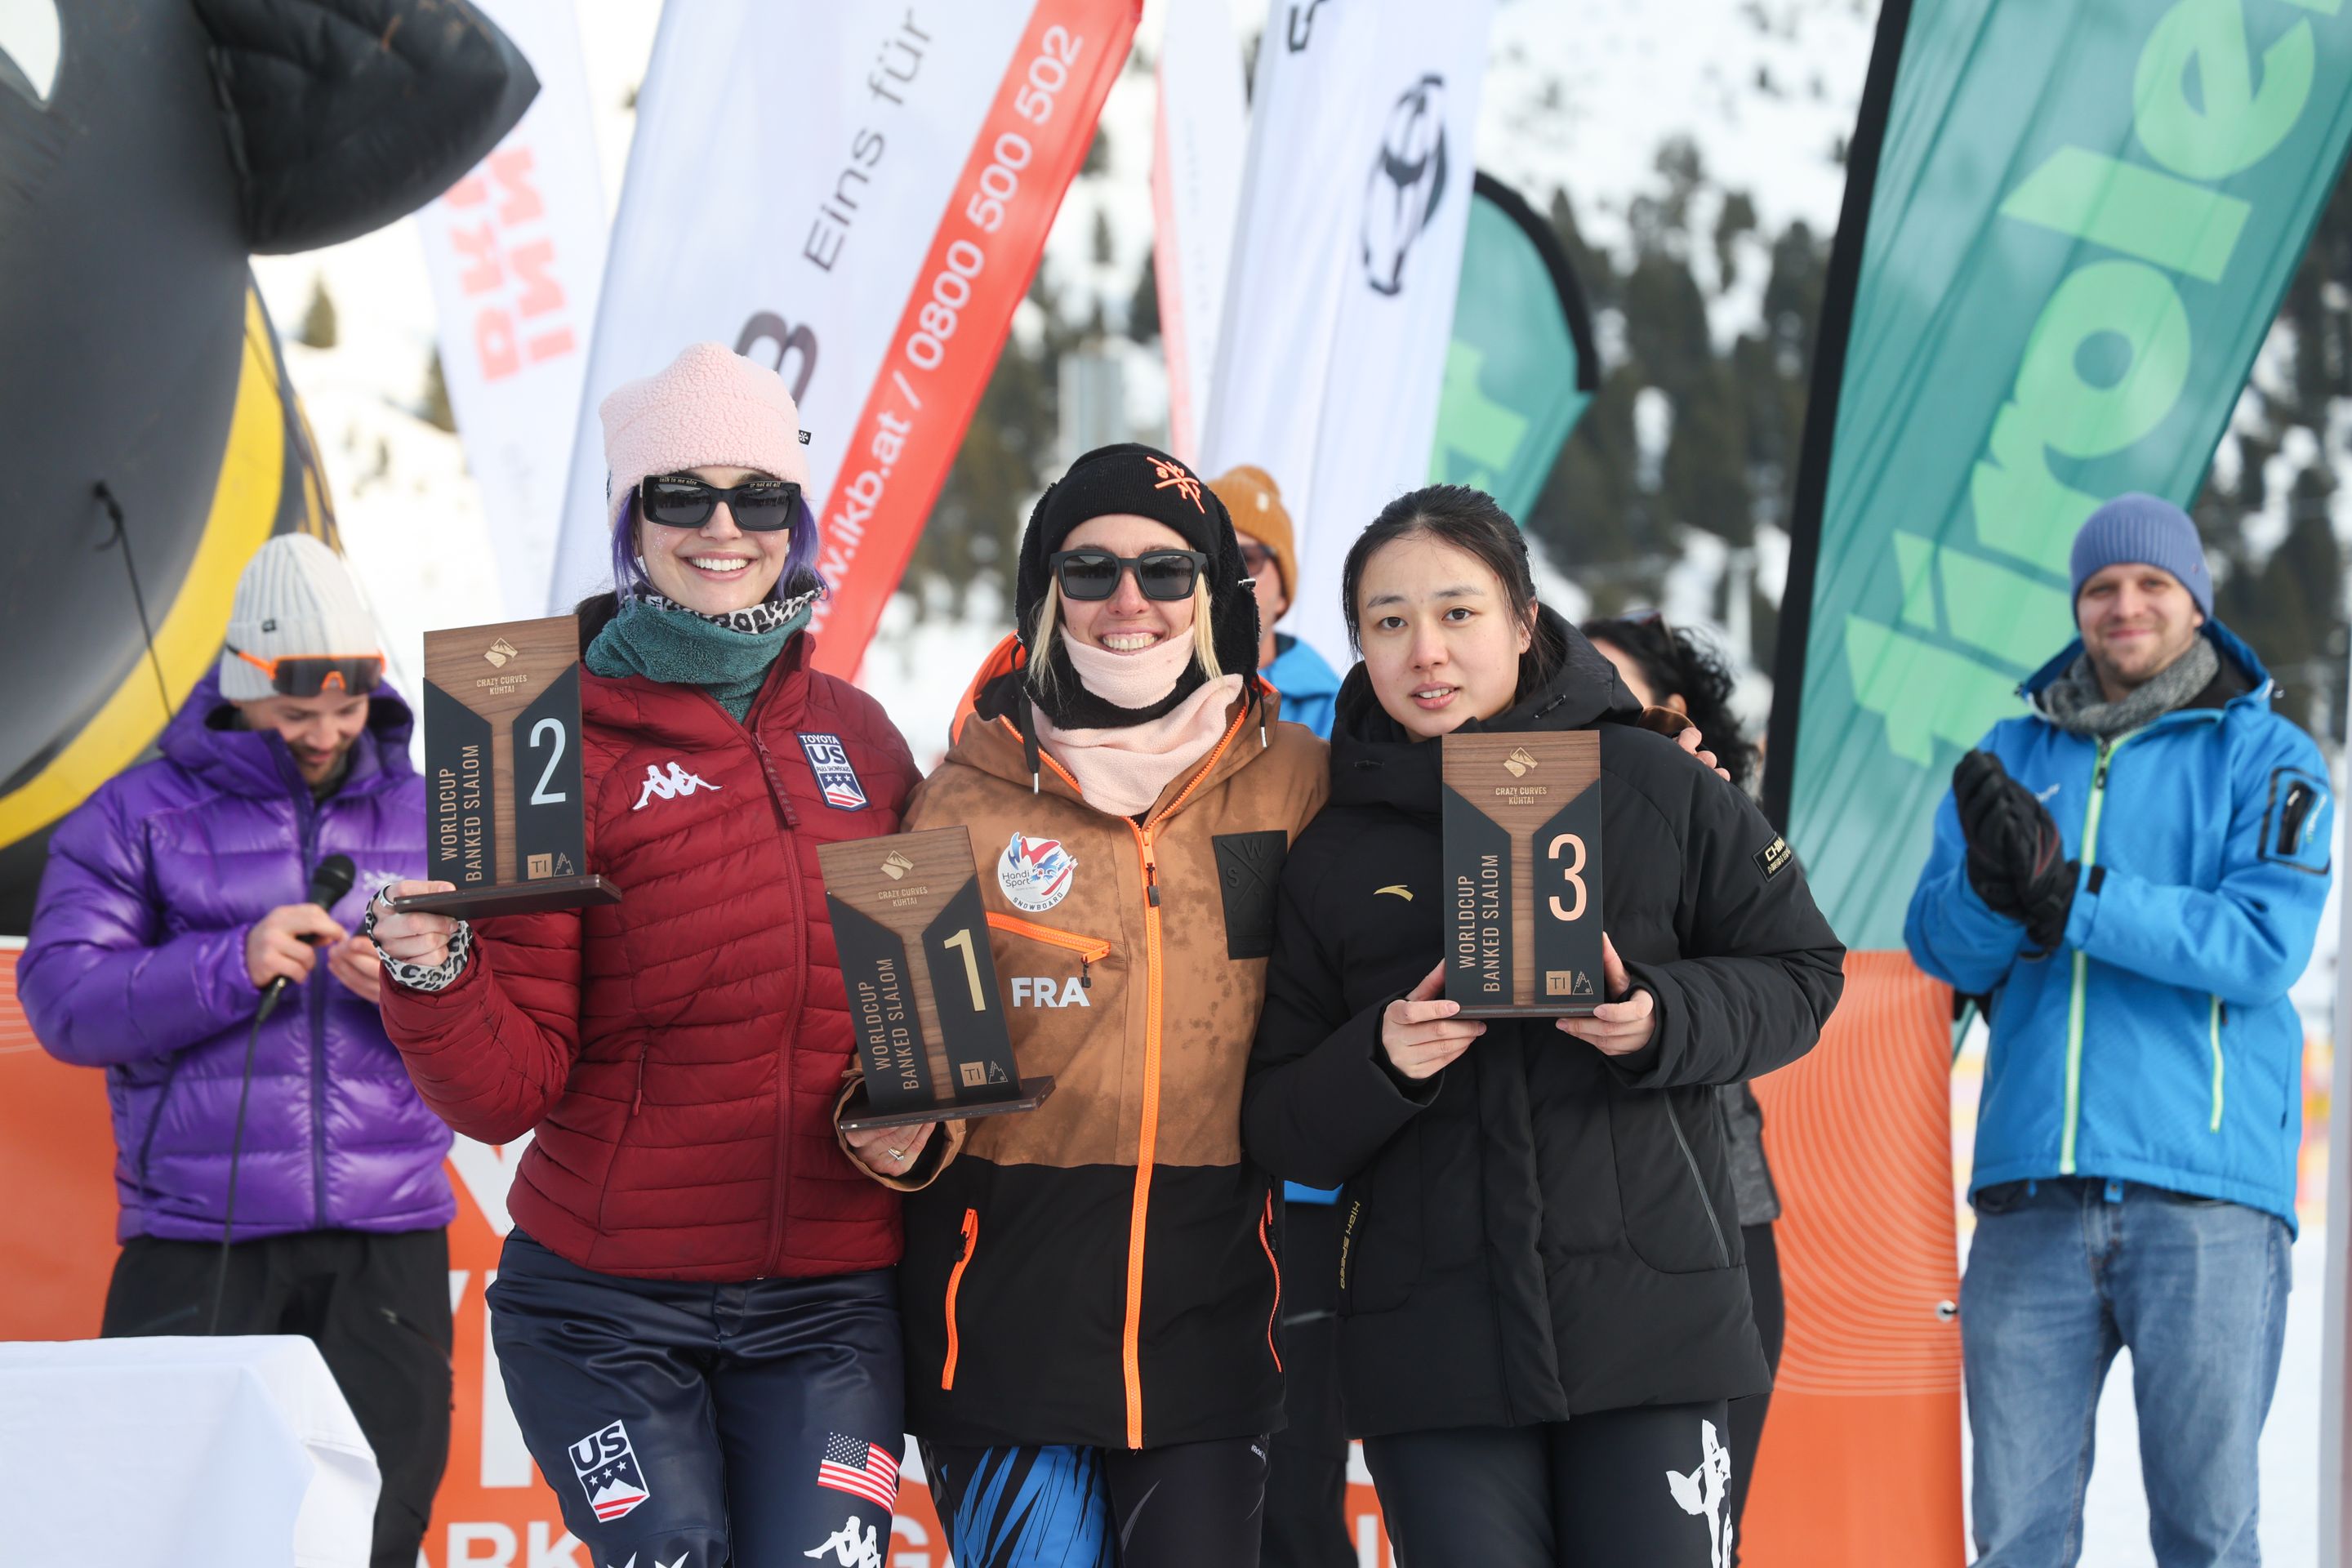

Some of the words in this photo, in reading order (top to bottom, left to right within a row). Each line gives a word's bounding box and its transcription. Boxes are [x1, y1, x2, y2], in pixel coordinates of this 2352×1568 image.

[804, 127, 887, 273] Eins
[871, 7, 933, 106] für
[905, 238, 985, 372] 0800
[964, 131, 1032, 234] 500
[1014, 24, 1083, 124] 502
[476, 676, 499, 688] CRAZY
[501, 675, 528, 685] CURVES
[529, 718, 567, 805] 2
[800, 735, 840, 744] TOYOTA
[808, 746, 845, 764] US
[461, 745, 480, 808] SLALOM
[1495, 786, 1518, 796] CRAZY
[1520, 786, 1548, 795] CURVES
[439, 768, 458, 862] WORLDCUP
[1508, 795, 1535, 805] KÜHTAI
[464, 817, 482, 882] BANKED
[532, 860, 548, 874] TI
[878, 889, 900, 899] CRAZY
[902, 885, 928, 897] CURVES
[1002, 870, 1030, 880] Handi
[1005, 879, 1031, 889] Sport
[1481, 854, 1499, 920] SLALOM
[1548, 833, 1588, 922] 3
[1012, 892, 1064, 911] SNOWBOARD
[1459, 875, 1475, 969] WORLDCUP
[942, 928, 987, 1013] 1
[1482, 926, 1501, 992] BANKED
[876, 958, 904, 1021] SLALOM
[1011, 977, 1090, 1009] FRA
[1550, 976, 1566, 990] TI
[858, 981, 890, 1071] WORLDCUP
[891, 1027, 920, 1090] BANKED
[964, 1069, 982, 1081] TI
[1345, 1200, 1361, 1236] HIGH
[573, 1425, 627, 1469] US
